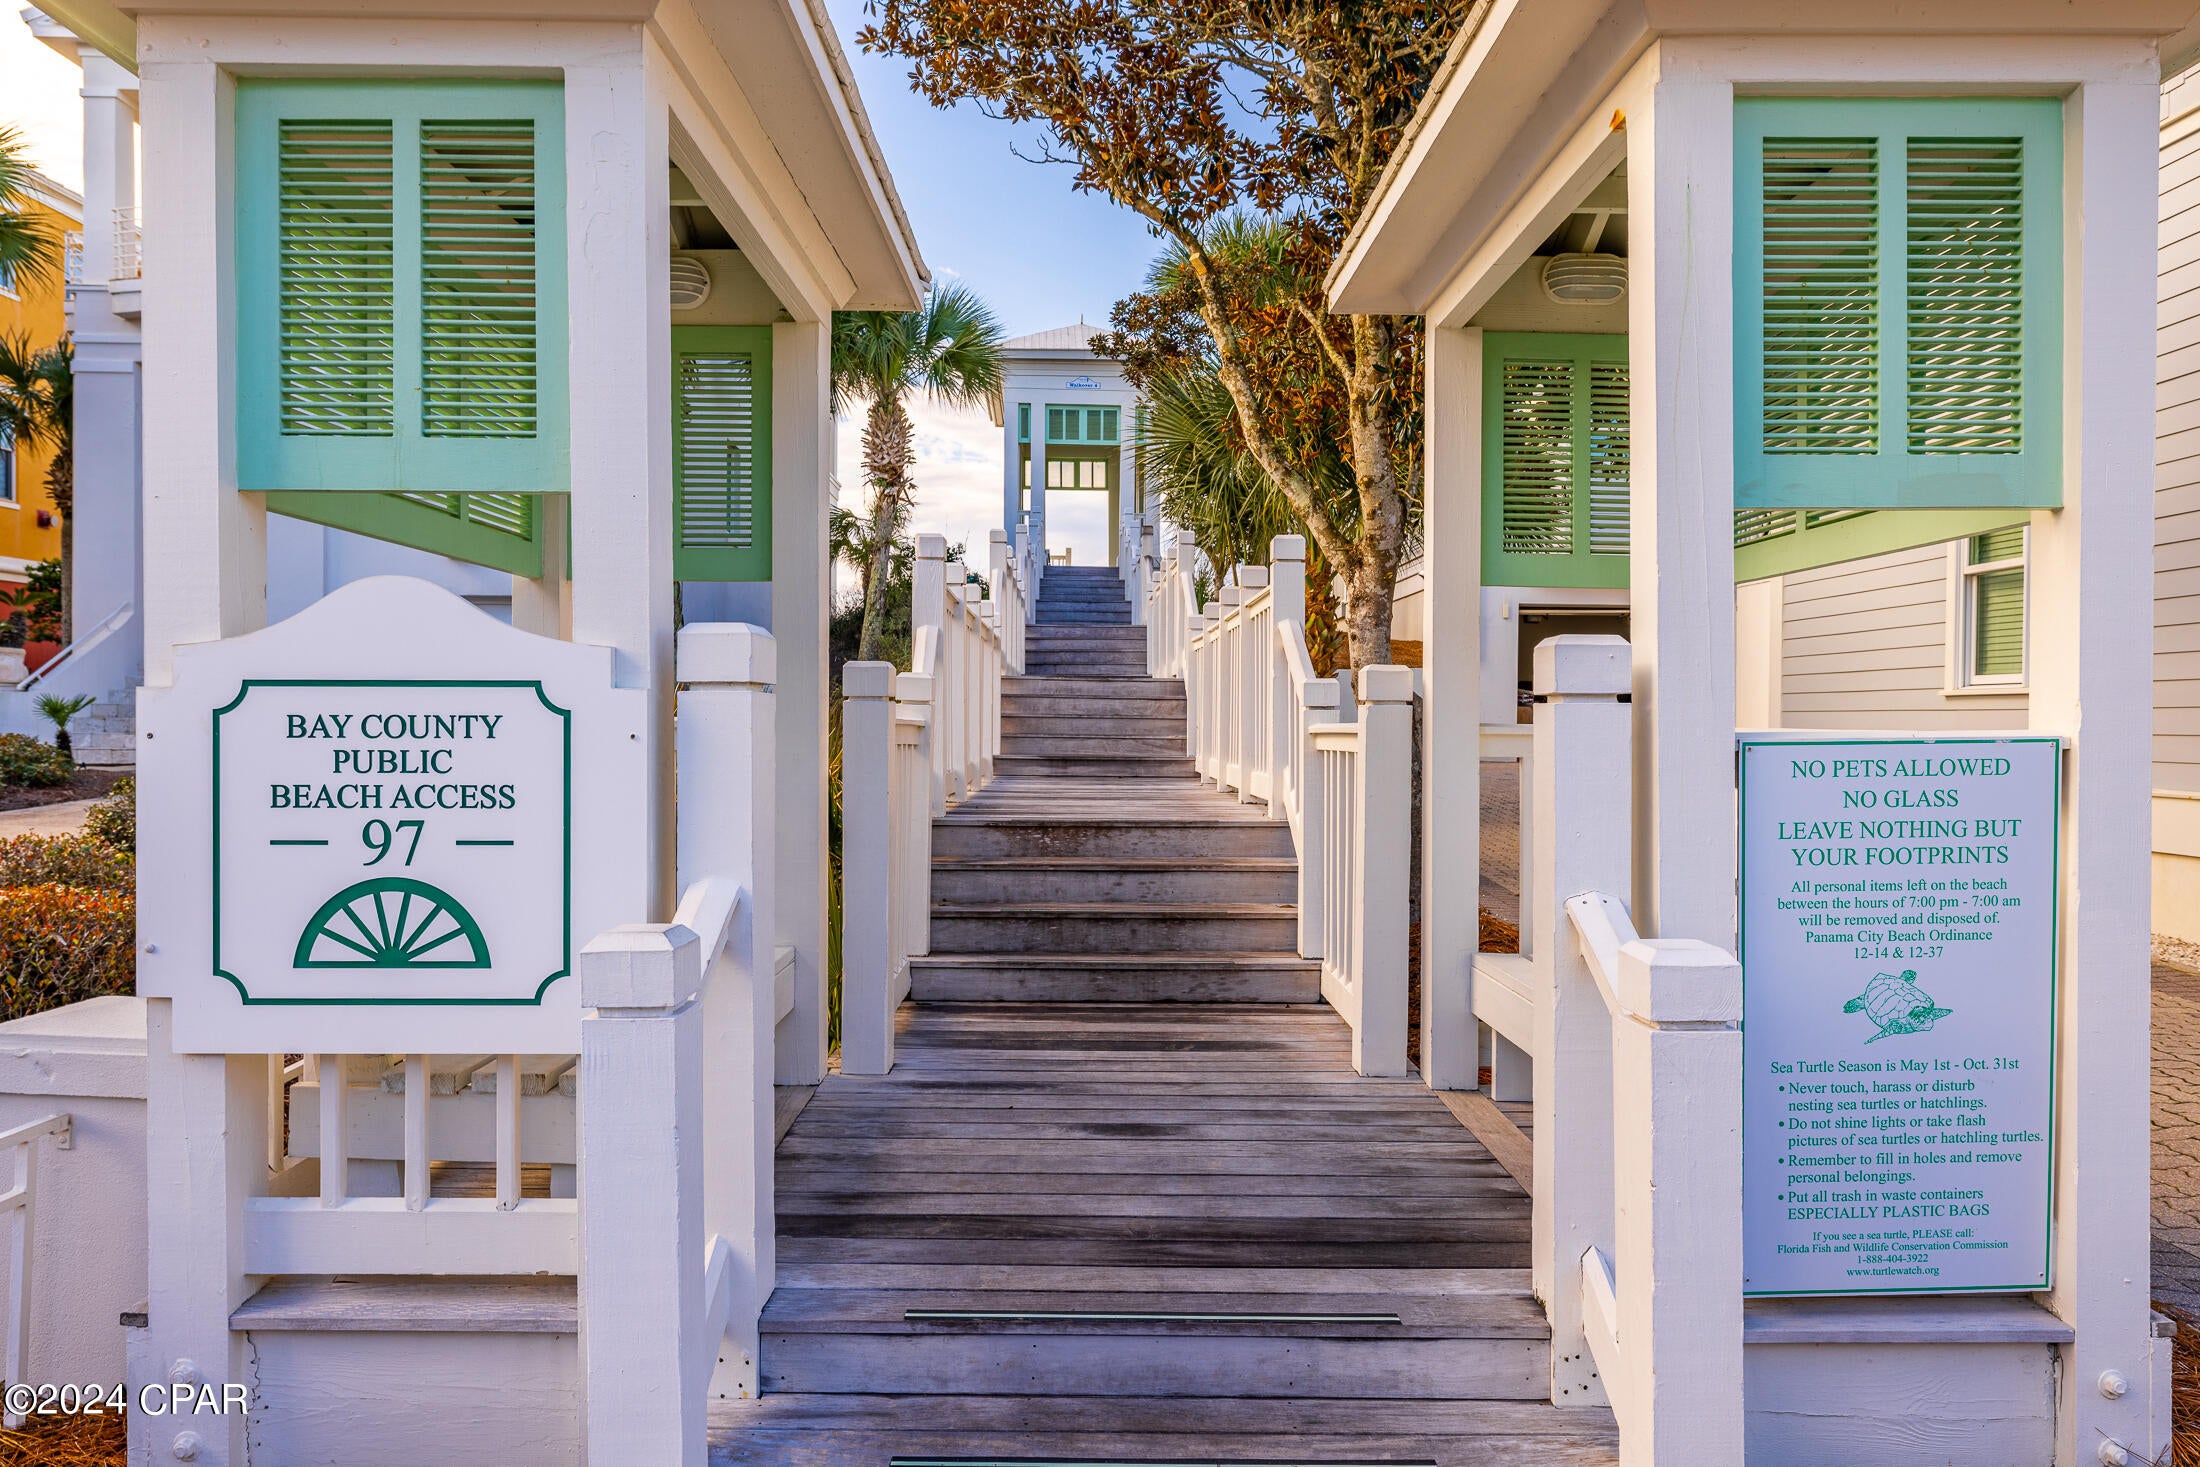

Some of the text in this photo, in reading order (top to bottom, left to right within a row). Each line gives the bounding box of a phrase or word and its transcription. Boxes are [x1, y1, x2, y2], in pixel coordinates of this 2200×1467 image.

[286, 714, 503, 739] BAY COUNTY
[333, 749, 452, 774] PUBLIC
[1791, 758, 2010, 778] NO PETS ALLOWED
[270, 784, 516, 809] BEACH ACCESS
[1842, 789, 1958, 808] NO GLASS
[1778, 819, 2022, 840] LEAVE NOTHING BUT
[362, 819, 425, 866] 97
[1791, 846, 2008, 866] YOUR FOOTPRINTS
[1792, 878, 2007, 895] All personal items left on the beach
[1777, 898, 1828, 910] between
[1832, 897, 1851, 909] the
[1855, 897, 1888, 908] hours
[1892, 896, 1907, 908] of
[1909, 896, 1936, 907] 7:00
[1940, 899, 1959, 910] pm
[1972, 895, 1998, 907] 7:00
[2001, 898, 2020, 907] am
[1798, 911, 2000, 927] will be removed and disposed of.
[1806, 929, 1992, 945] Panama City Beach Ordinance
[1855, 945, 1943, 959] 12-14 & 12-37
[1771, 1061, 1793, 1073] Sea
[1797, 1060, 1834, 1073] Turtle
[1838, 1060, 1882, 1072] Season
[1886, 1059, 1896, 1071] is
[1900, 1059, 1928, 1074] May
[1934, 1059, 1950, 1070] 1st
[1963, 1058, 1988, 1070] Oct.
[1993, 1058, 2019, 1070] 31st
[1789, 1079, 1975, 1095] Never touch, harass or disturb
[1789, 1096, 1987, 1114] nesting sea turtles or hatchlings.
[1788, 1114, 1986, 1131] Do not shine lights or take flash
[1788, 1130, 2043, 1150] pictures of sea turtles or hatchling turtles.
[1788, 1151, 2022, 1166] Remember to fill in holes and remove
[1788, 1170, 1915, 1186] personal belongings.
[1788, 1188, 1983, 1203] Put all trash in waste containers
[1788, 1204, 1990, 1220] ESPECIALLY PLASTIC BAGS
[1813, 1232, 1822, 1242] If
[1823, 1234, 1840, 1243] you
[1884, 1230, 1910, 1240] turtle,
[1913, 1229, 1952, 1238] PLEASE
[1955, 1228, 1974, 1237] call:
[1778, 1240, 2008, 1254] Florida Fish and Wildlife Conservation Commission
[1858, 1254, 1928, 1264] 1-888-404-3922
[1847, 1266, 1940, 1276] www.turtlewatch.org
